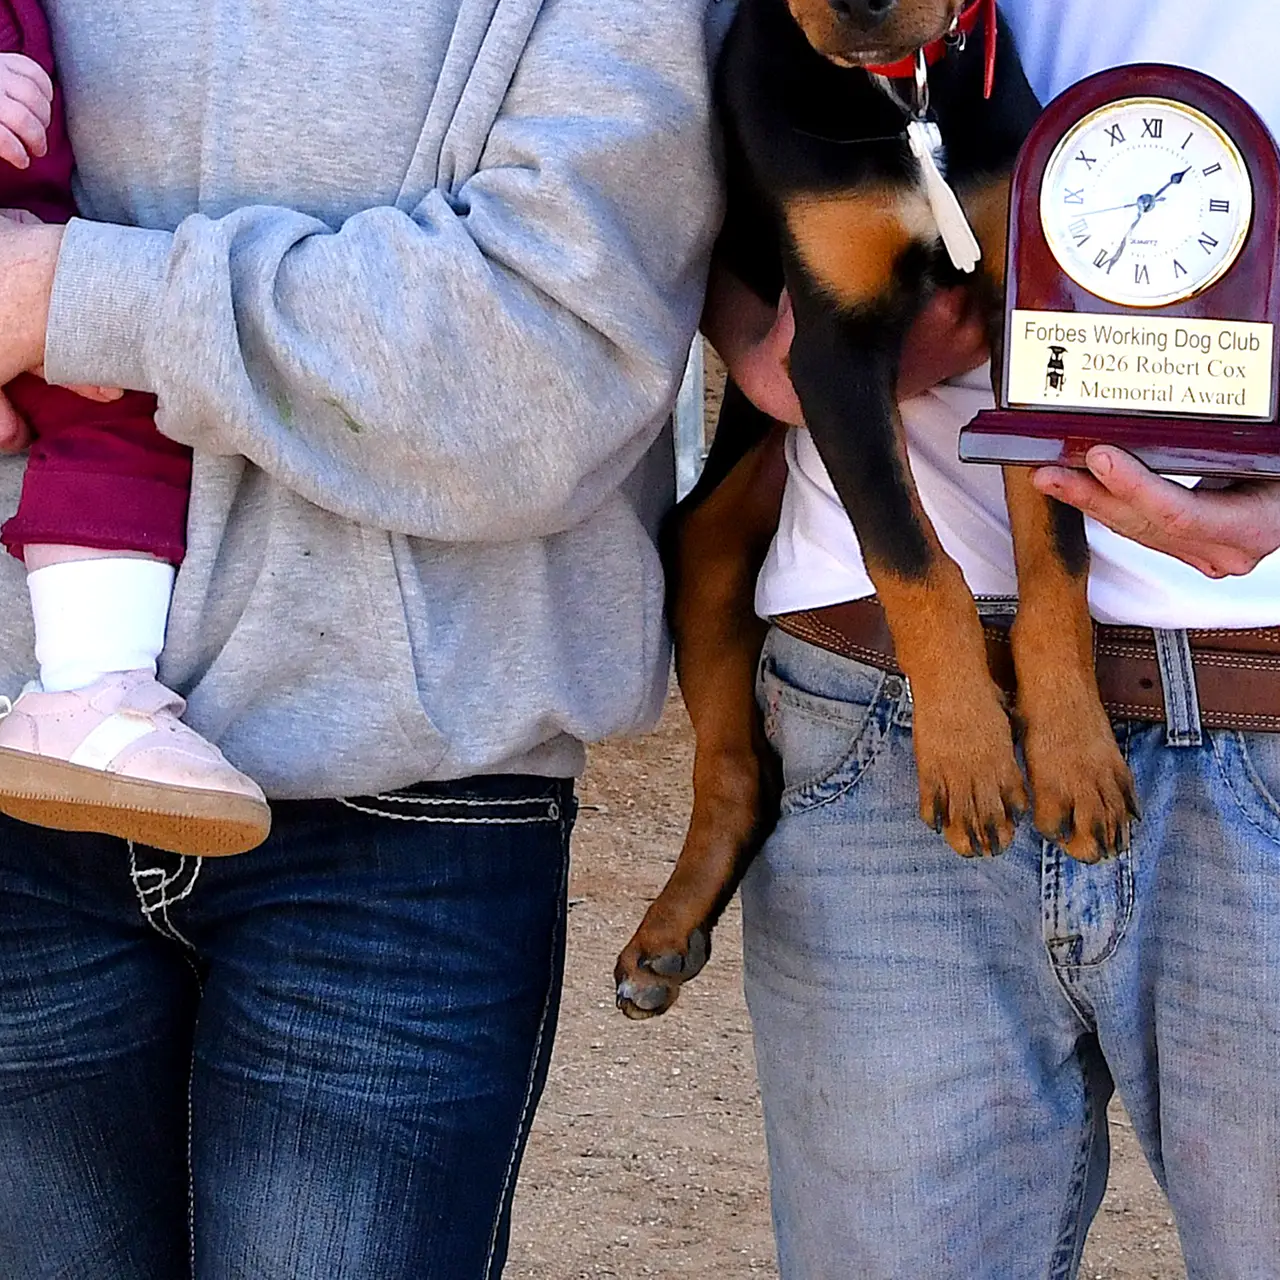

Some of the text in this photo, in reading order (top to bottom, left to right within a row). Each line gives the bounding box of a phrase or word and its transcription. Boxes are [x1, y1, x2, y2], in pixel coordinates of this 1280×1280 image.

[1140, 117, 1163, 139] XII
[1075, 150, 1097, 170] X
[1209, 198, 1230, 213] III
[1024, 321, 1261, 354] Forbes Working Dog Club
[1081, 352, 1247, 379] 2026 Robert Cox
[1080, 380, 1246, 407] Memorial Award
